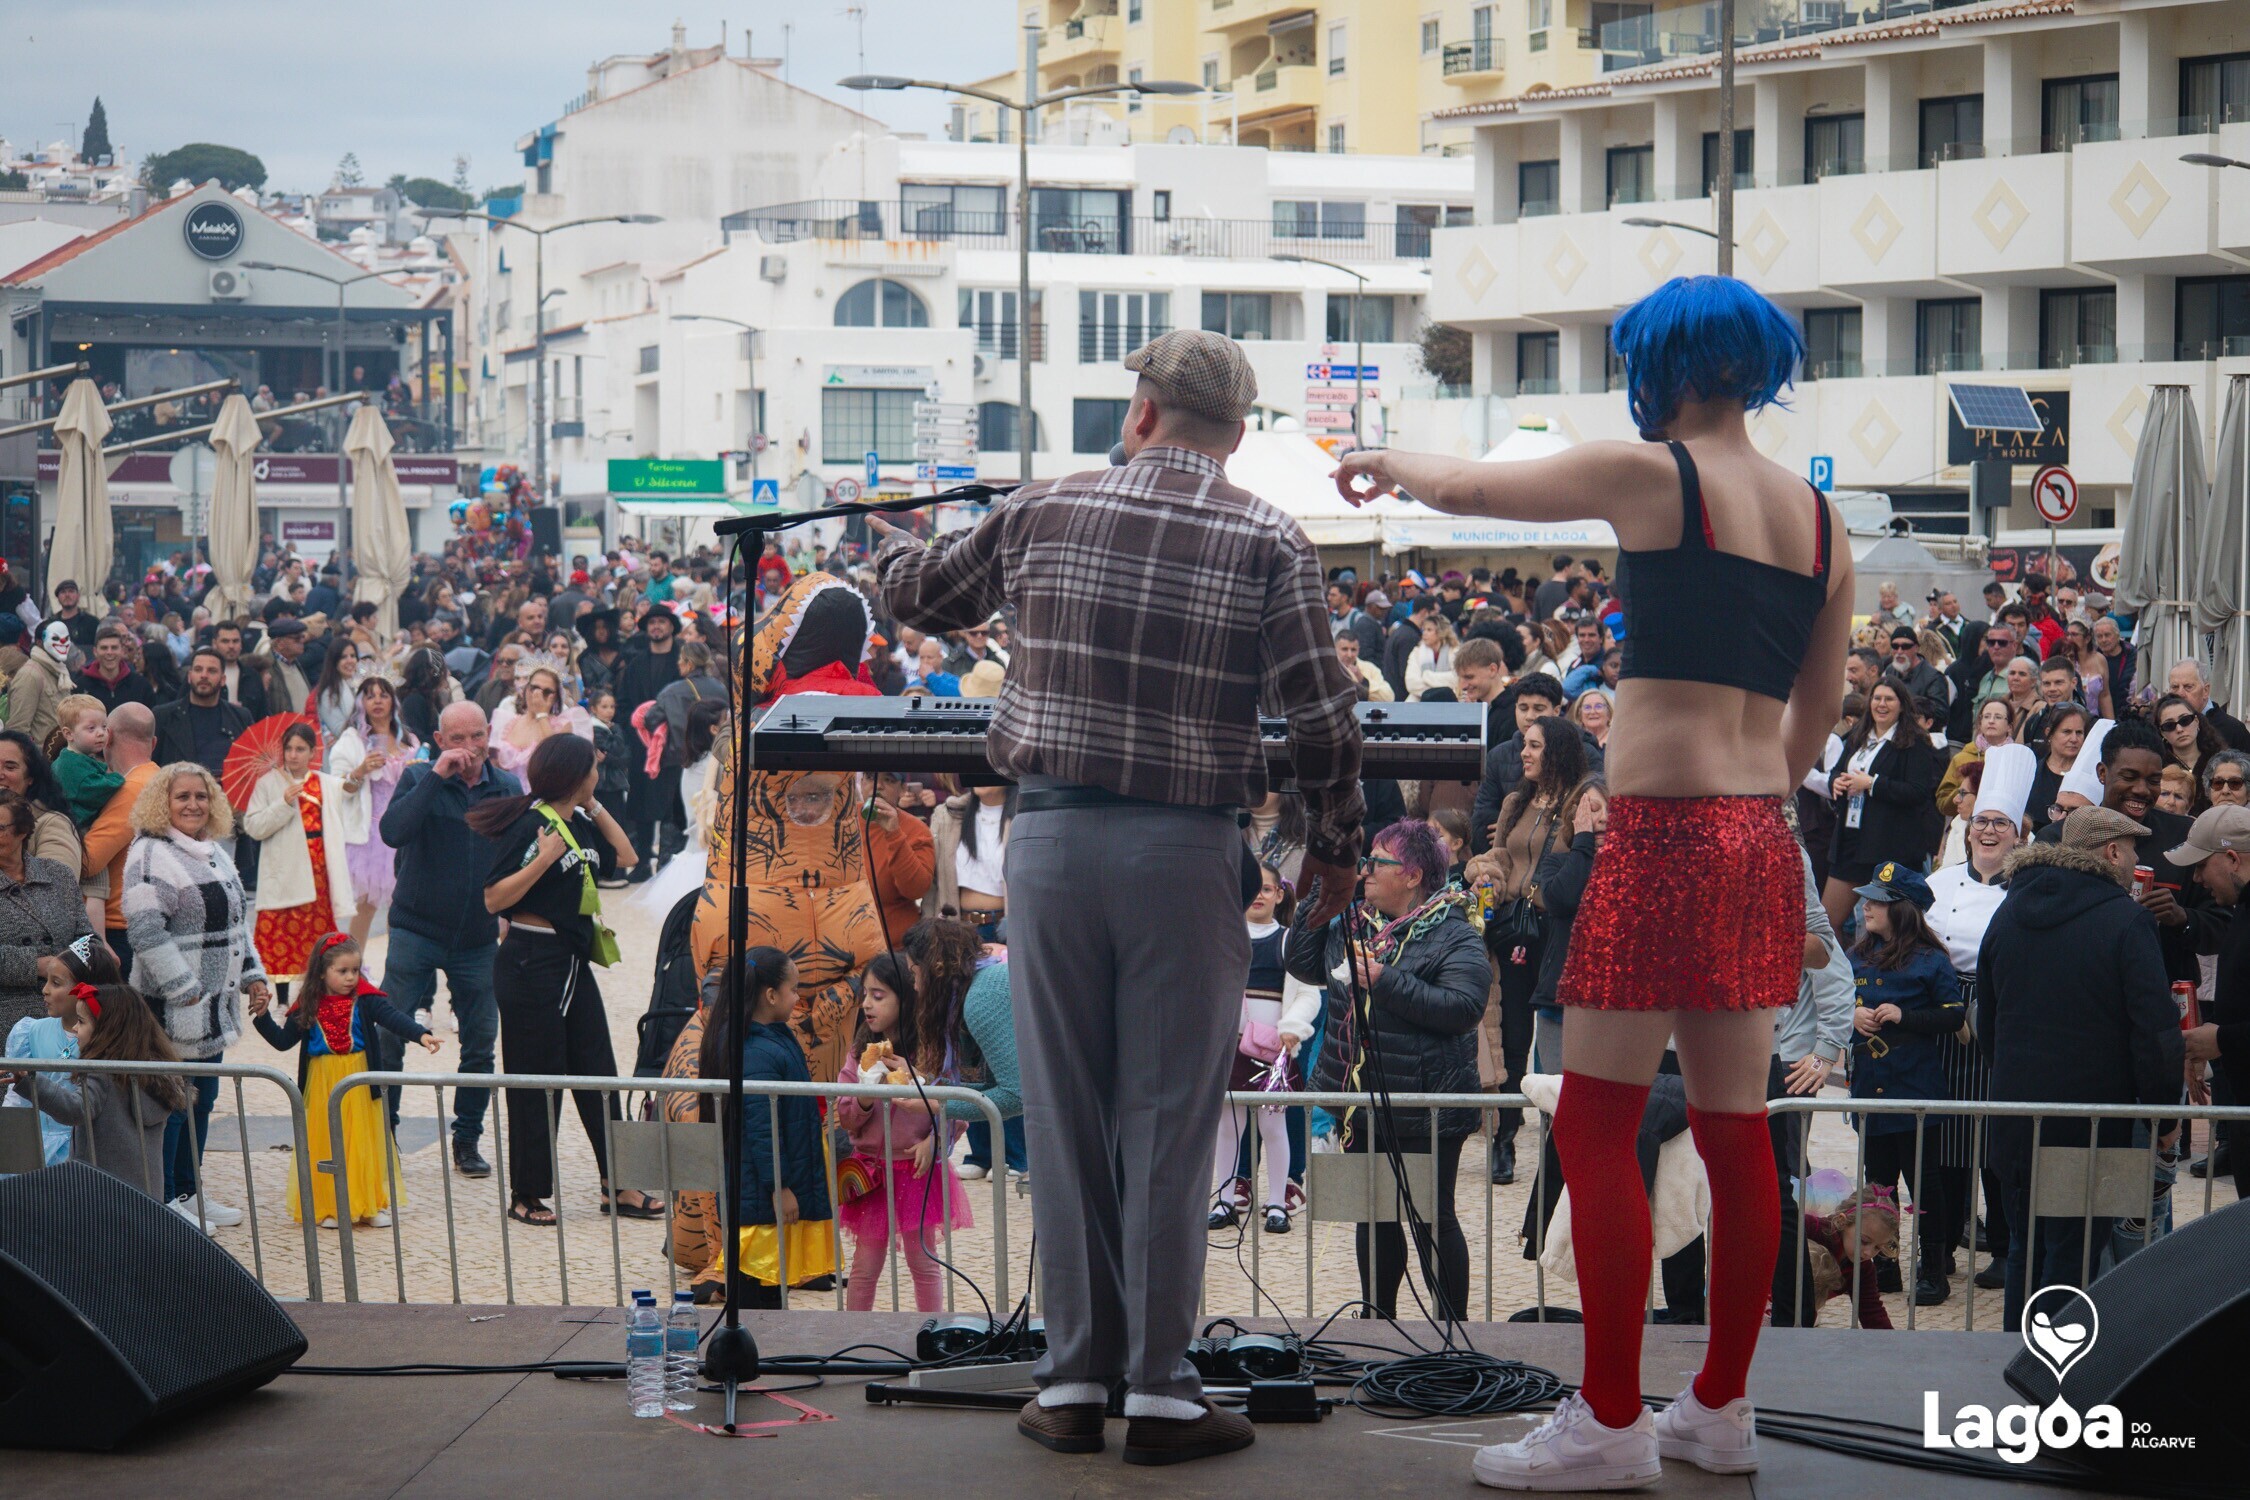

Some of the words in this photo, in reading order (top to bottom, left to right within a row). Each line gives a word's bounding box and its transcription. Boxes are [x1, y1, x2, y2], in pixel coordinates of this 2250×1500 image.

[1309, 390, 1348, 400] mercado
[1975, 426, 2066, 447] PLAZA
[2001, 448, 2038, 458] HOTEL
[1814, 459, 1829, 489] P
[839, 485, 857, 497] 30
[1452, 530, 1520, 542] MUNICÍPIO
[1523, 531, 1539, 541] DE
[1544, 531, 1588, 542] LAGOA
